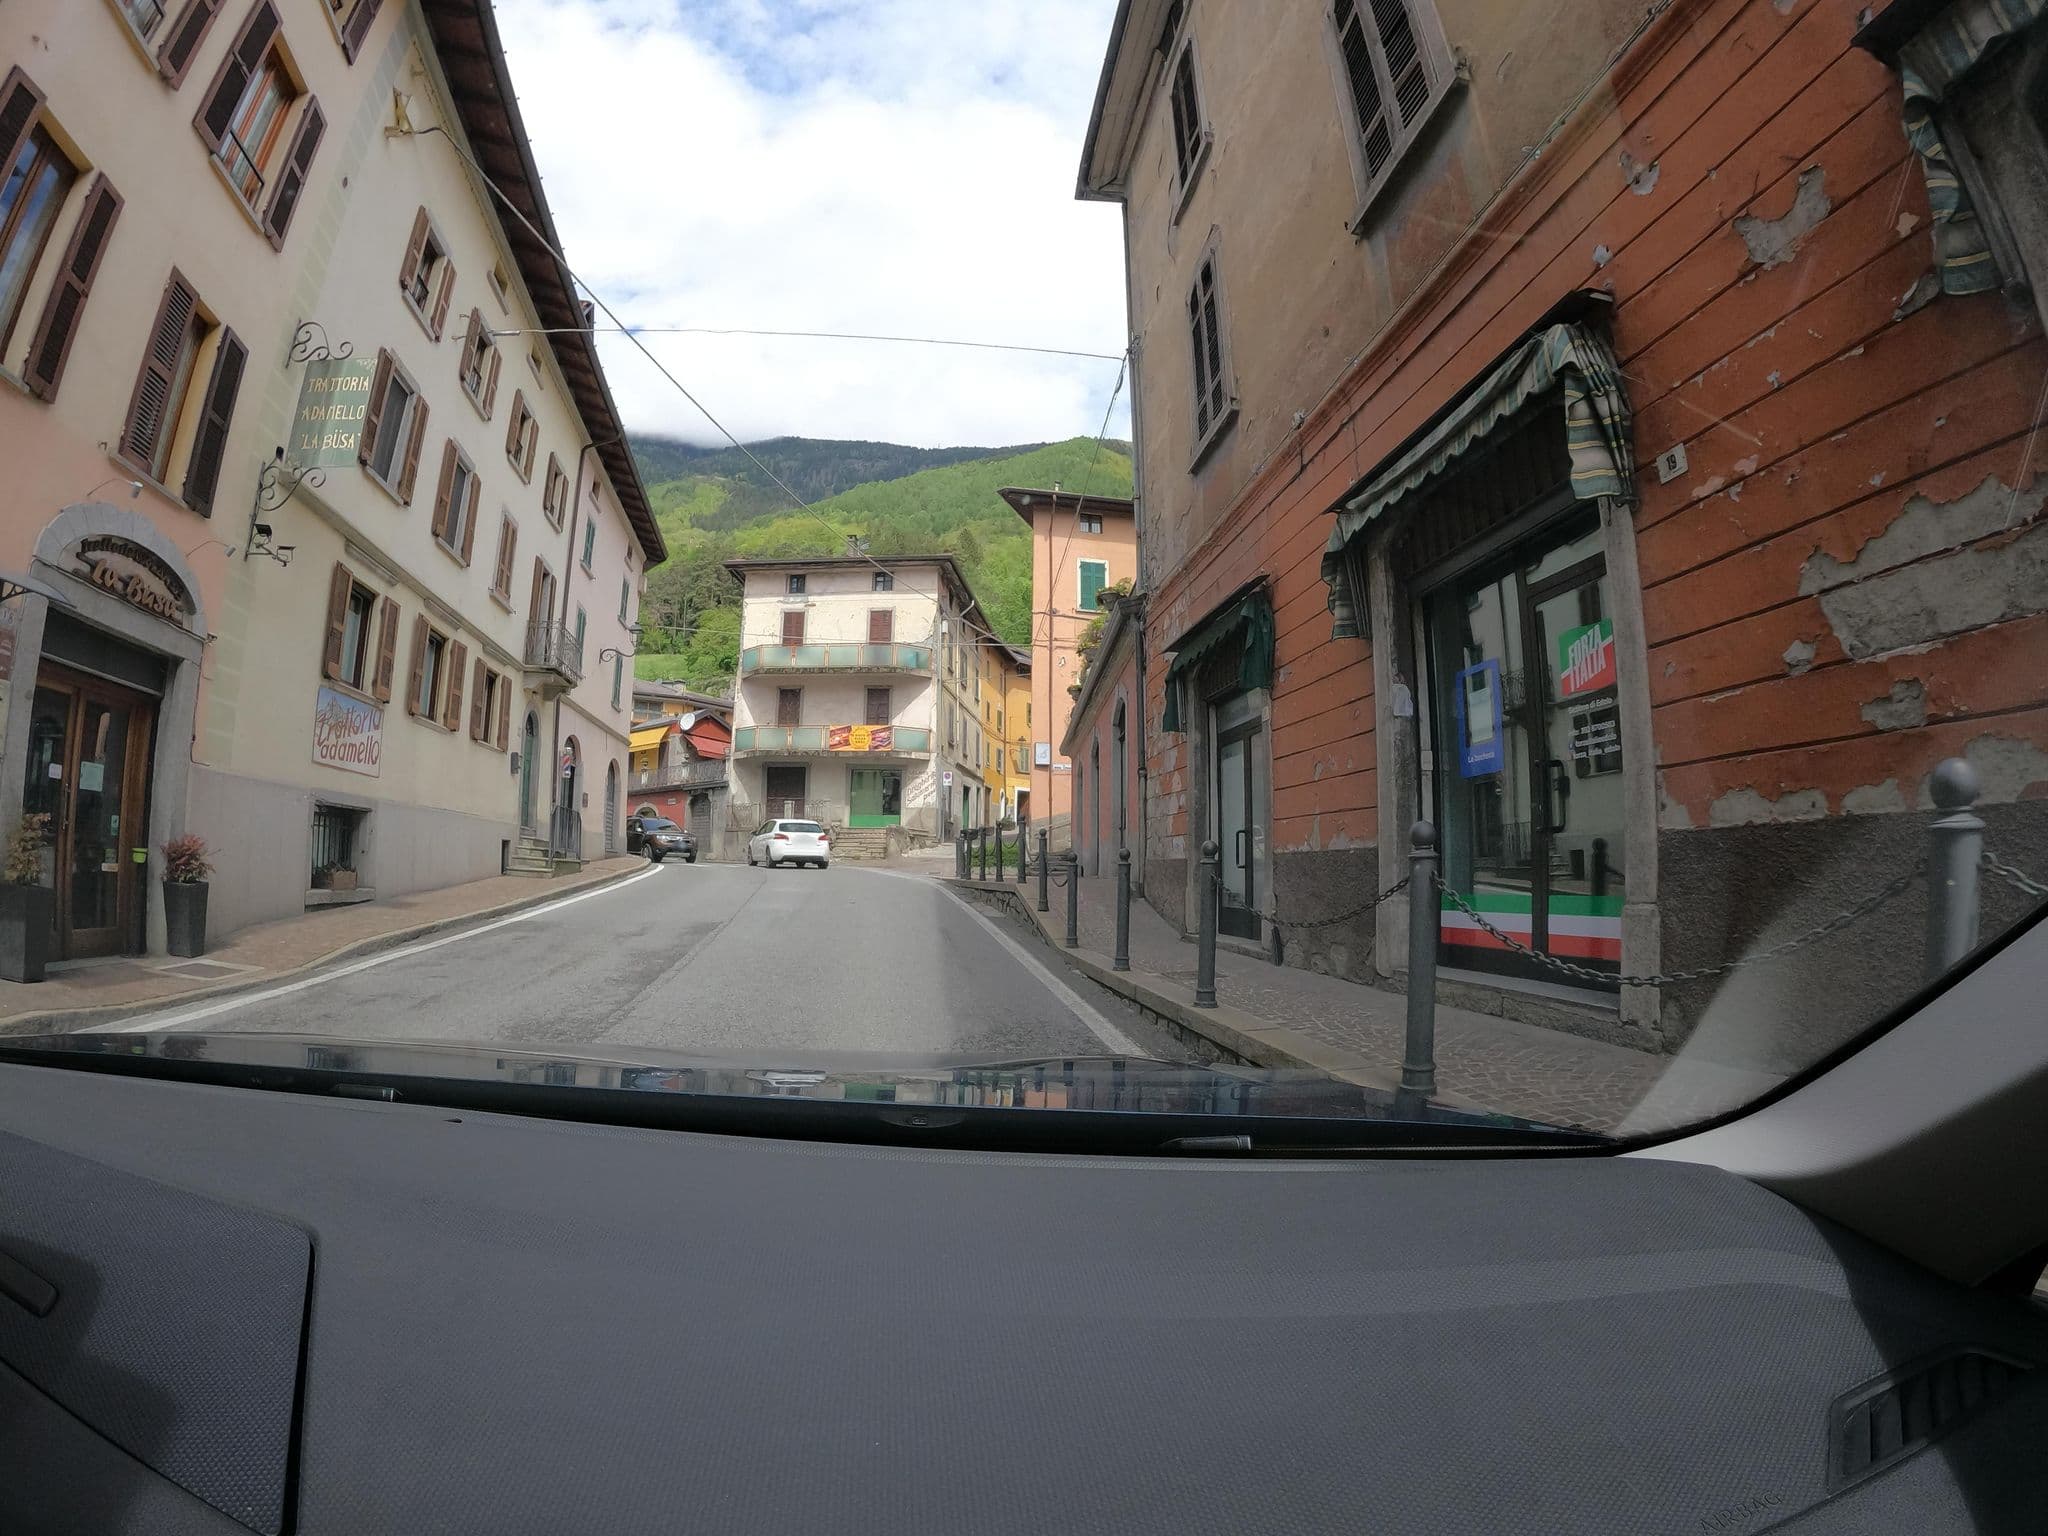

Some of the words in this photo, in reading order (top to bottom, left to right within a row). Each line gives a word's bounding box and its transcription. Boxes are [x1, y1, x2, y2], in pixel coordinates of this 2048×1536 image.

[307, 376, 369, 393] TRATTORIA
[302, 405, 366, 420] ADAMELLO
[1666, 454, 1677, 471] 19
[1569, 624, 1602, 667] FORZA
[1569, 649, 1607, 692] ITALIA
[320, 736, 380, 765] adamello
[1699, 1492, 1783, 1536] AIRBAG
